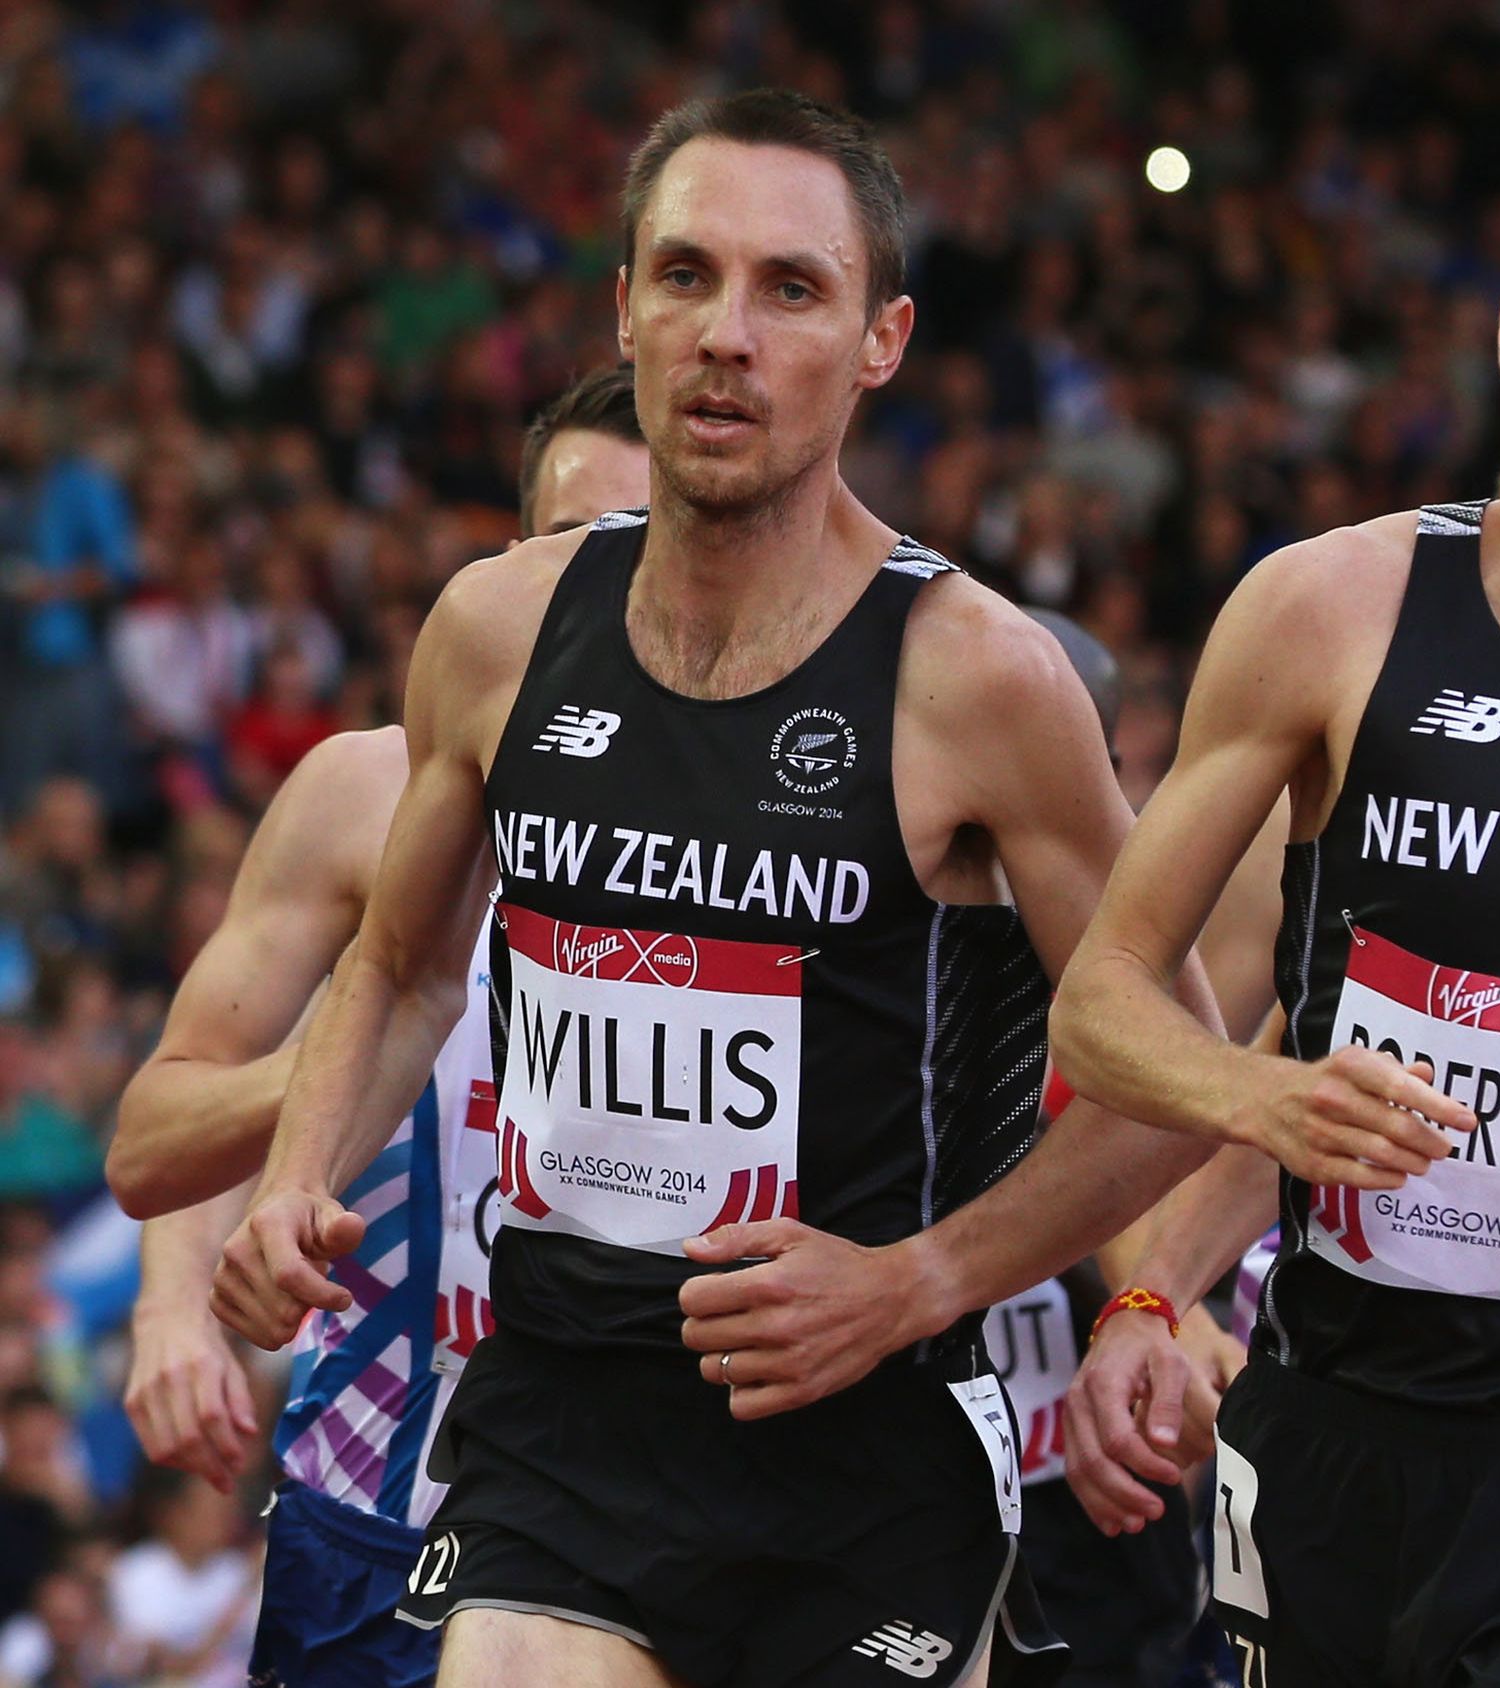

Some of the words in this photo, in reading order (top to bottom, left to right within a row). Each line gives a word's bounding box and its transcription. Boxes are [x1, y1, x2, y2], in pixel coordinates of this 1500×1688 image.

[770, 708, 846, 760] COMMONWEALTH
[843, 727, 857, 768] GAMES
[775, 769, 794, 788] NEW
[793, 776, 839, 794] ZEALAND
[758, 800, 816, 815] GLASGOW
[818, 808, 843, 819] 2014
[1362, 793, 1500, 875] NEW
[495, 809, 598, 886] NEW
[604, 827, 870, 923] ZEALAND
[561, 925, 625, 978] Virgin
[653, 949, 691, 967] media
[519, 989, 778, 1130] WILLIS
[540, 1150, 653, 1185] GLASGOW
[660, 1168, 707, 1193] 2014
[559, 1175, 574, 1185] XX
[576, 1177, 653, 1200] COMMONWEALTH
[655, 1191, 688, 1205] GAMES
[1391, 1222, 1407, 1234] XX
